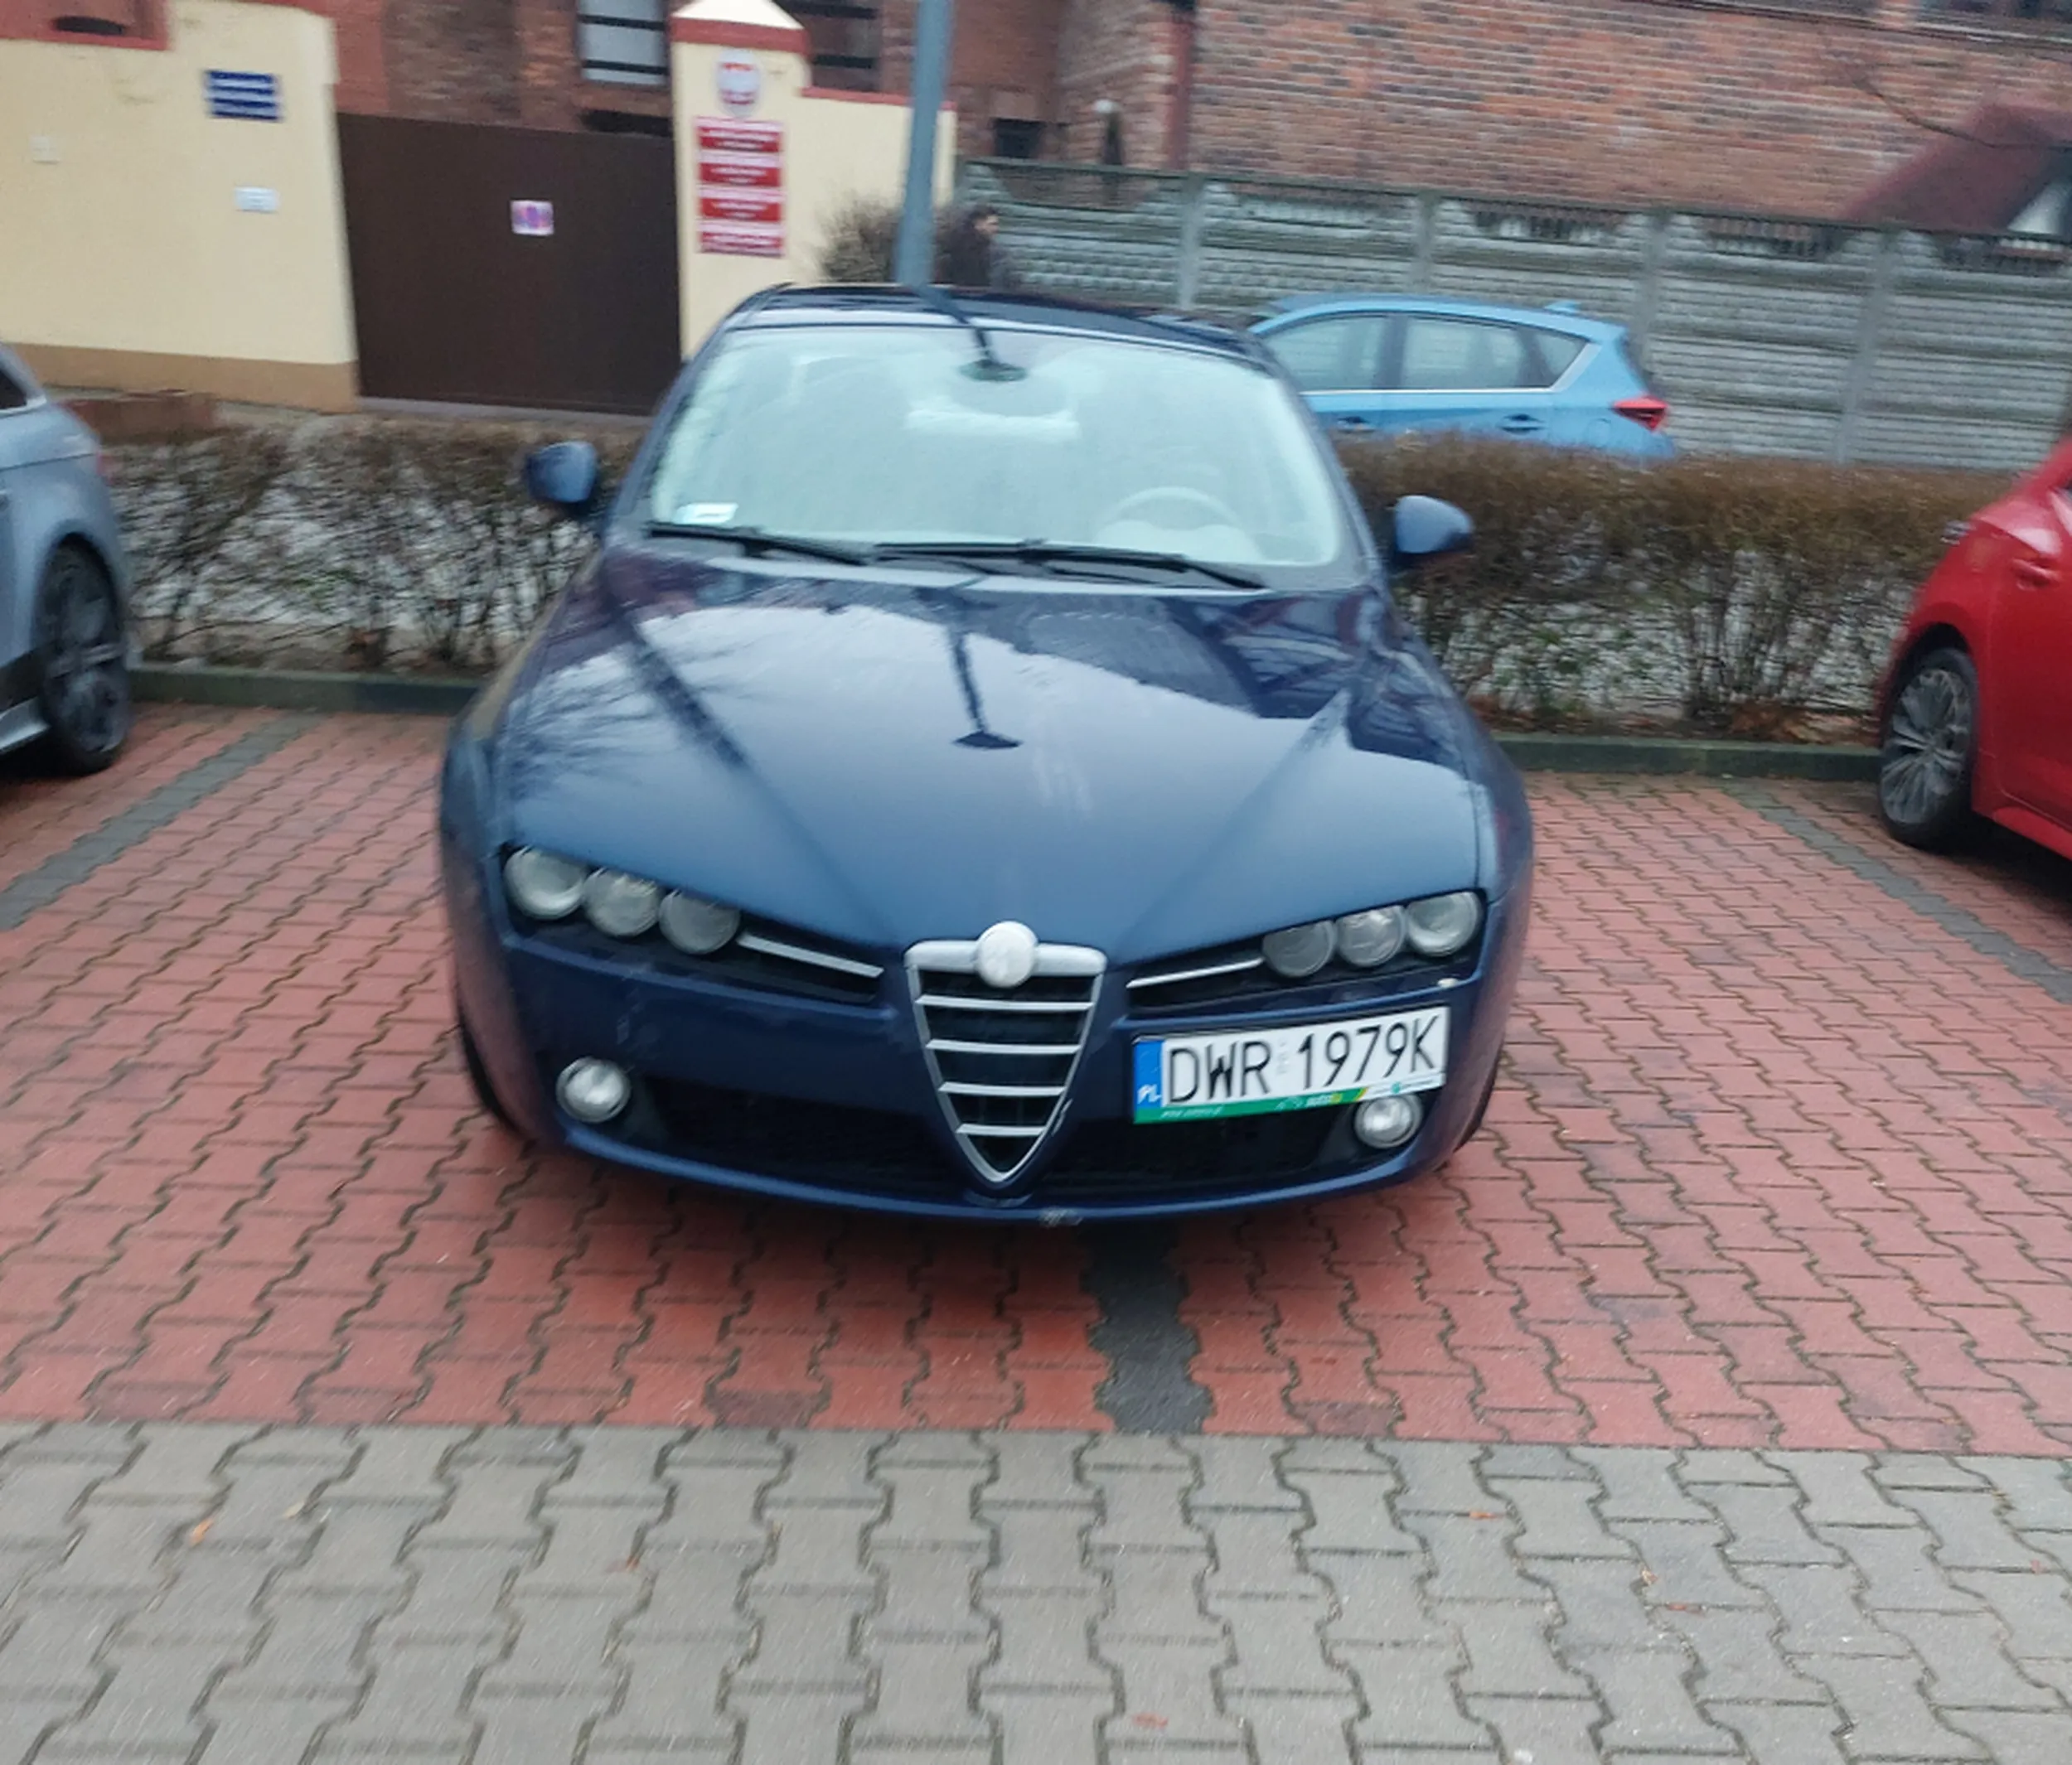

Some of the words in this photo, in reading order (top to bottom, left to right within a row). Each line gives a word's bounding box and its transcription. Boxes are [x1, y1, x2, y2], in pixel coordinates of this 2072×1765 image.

[1168, 1039, 1271, 1104] DWR
[1297, 1014, 1439, 1090] 1979K
[1137, 1083, 1162, 1105] PL
